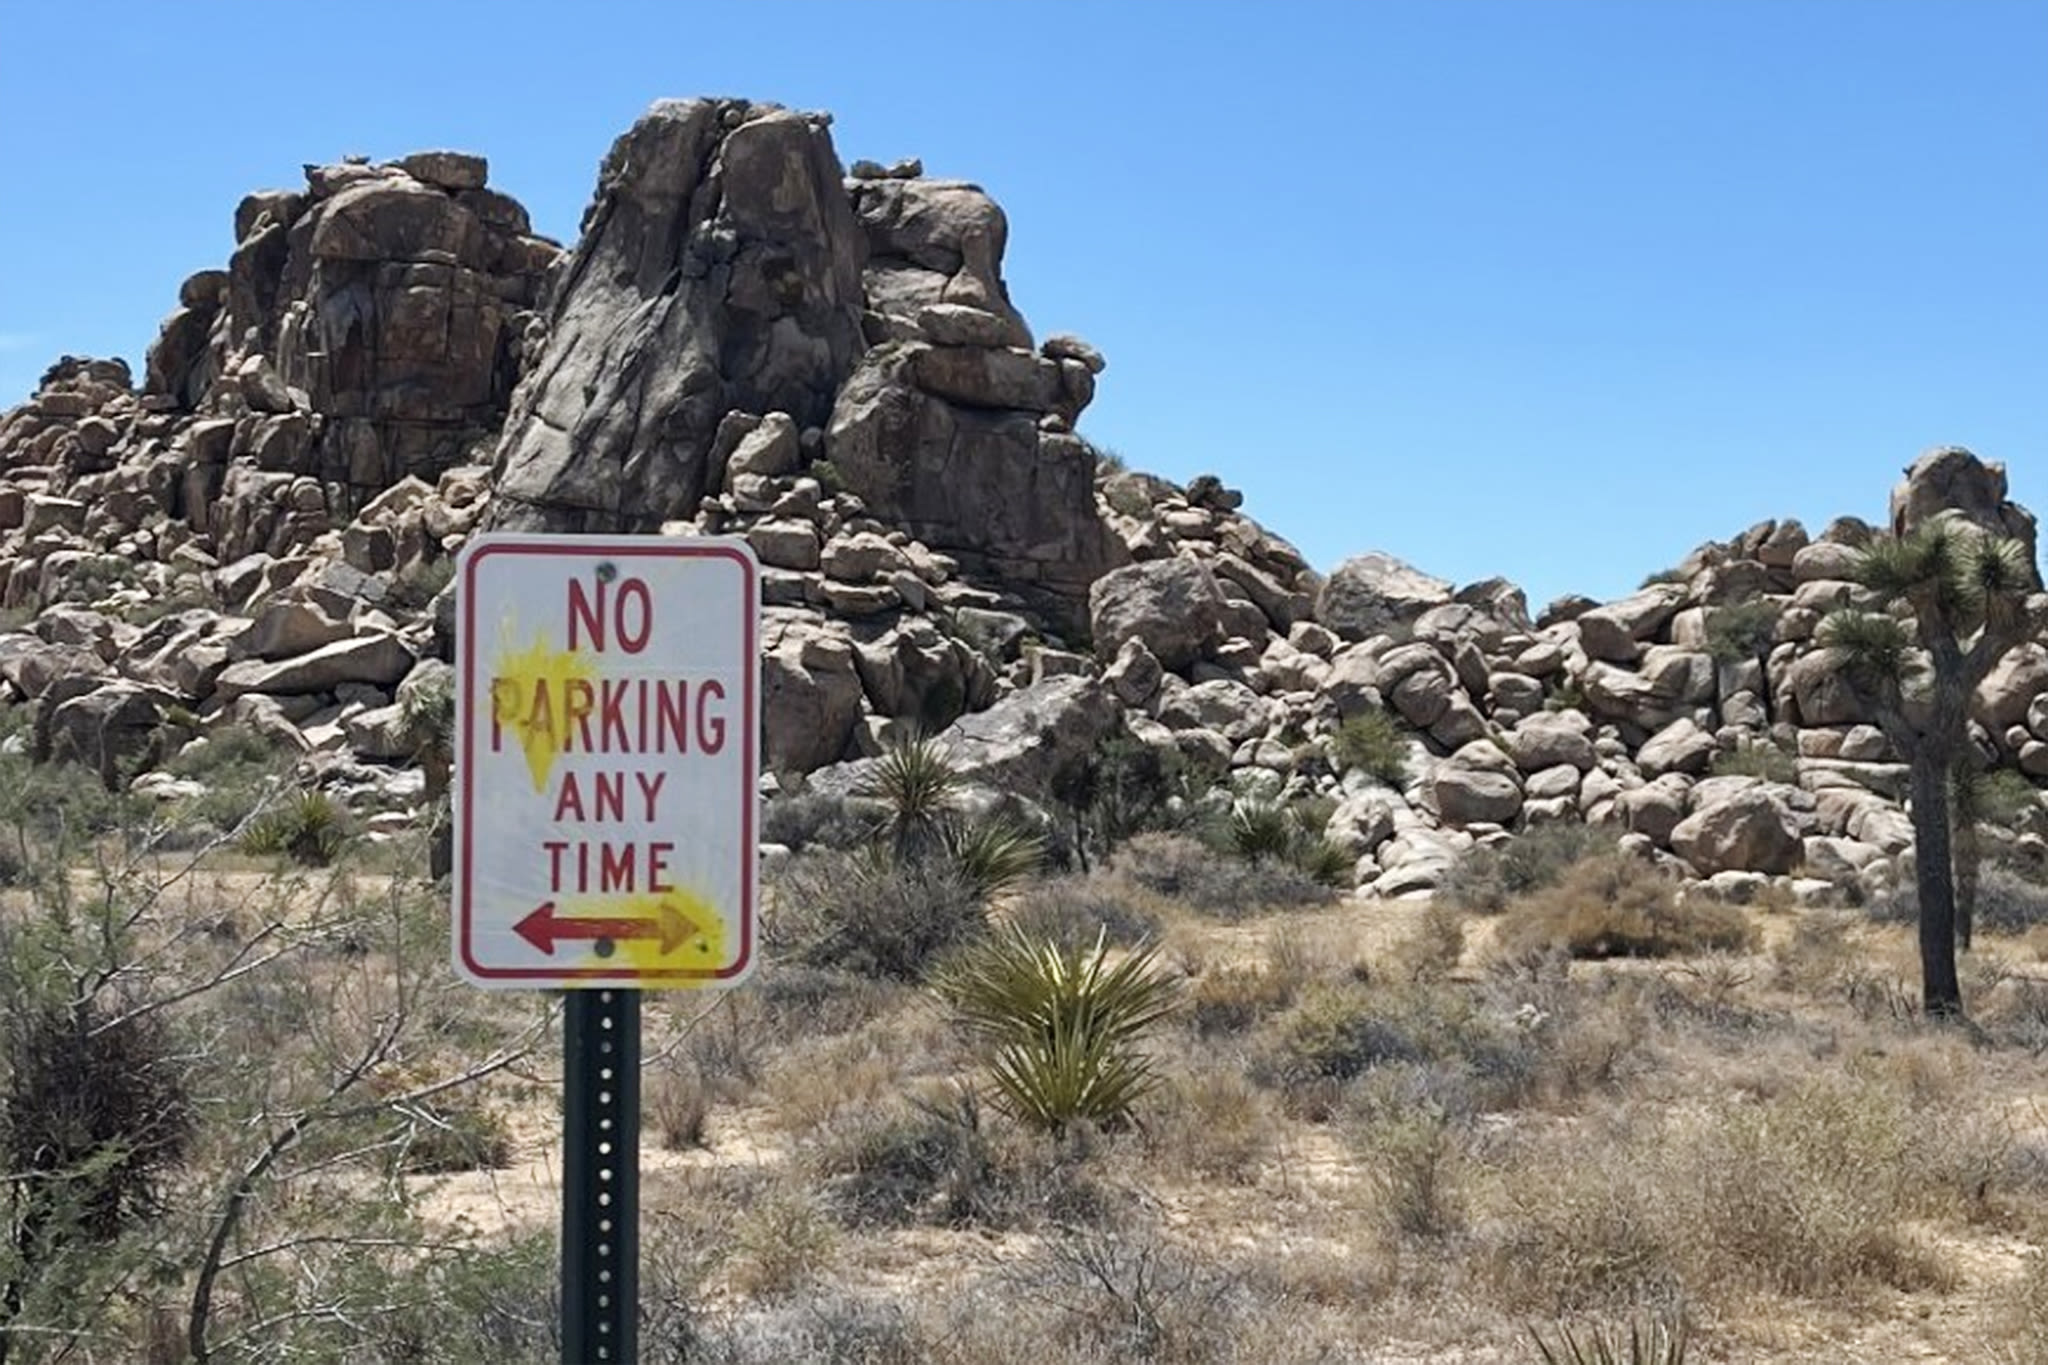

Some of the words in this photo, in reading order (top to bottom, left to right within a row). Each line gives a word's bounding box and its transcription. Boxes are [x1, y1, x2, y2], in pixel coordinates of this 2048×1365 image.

[568, 577, 653, 654] NO
[490, 678, 726, 755] PARKING
[553, 771, 667, 822] ANY
[543, 842, 675, 893] TIME
